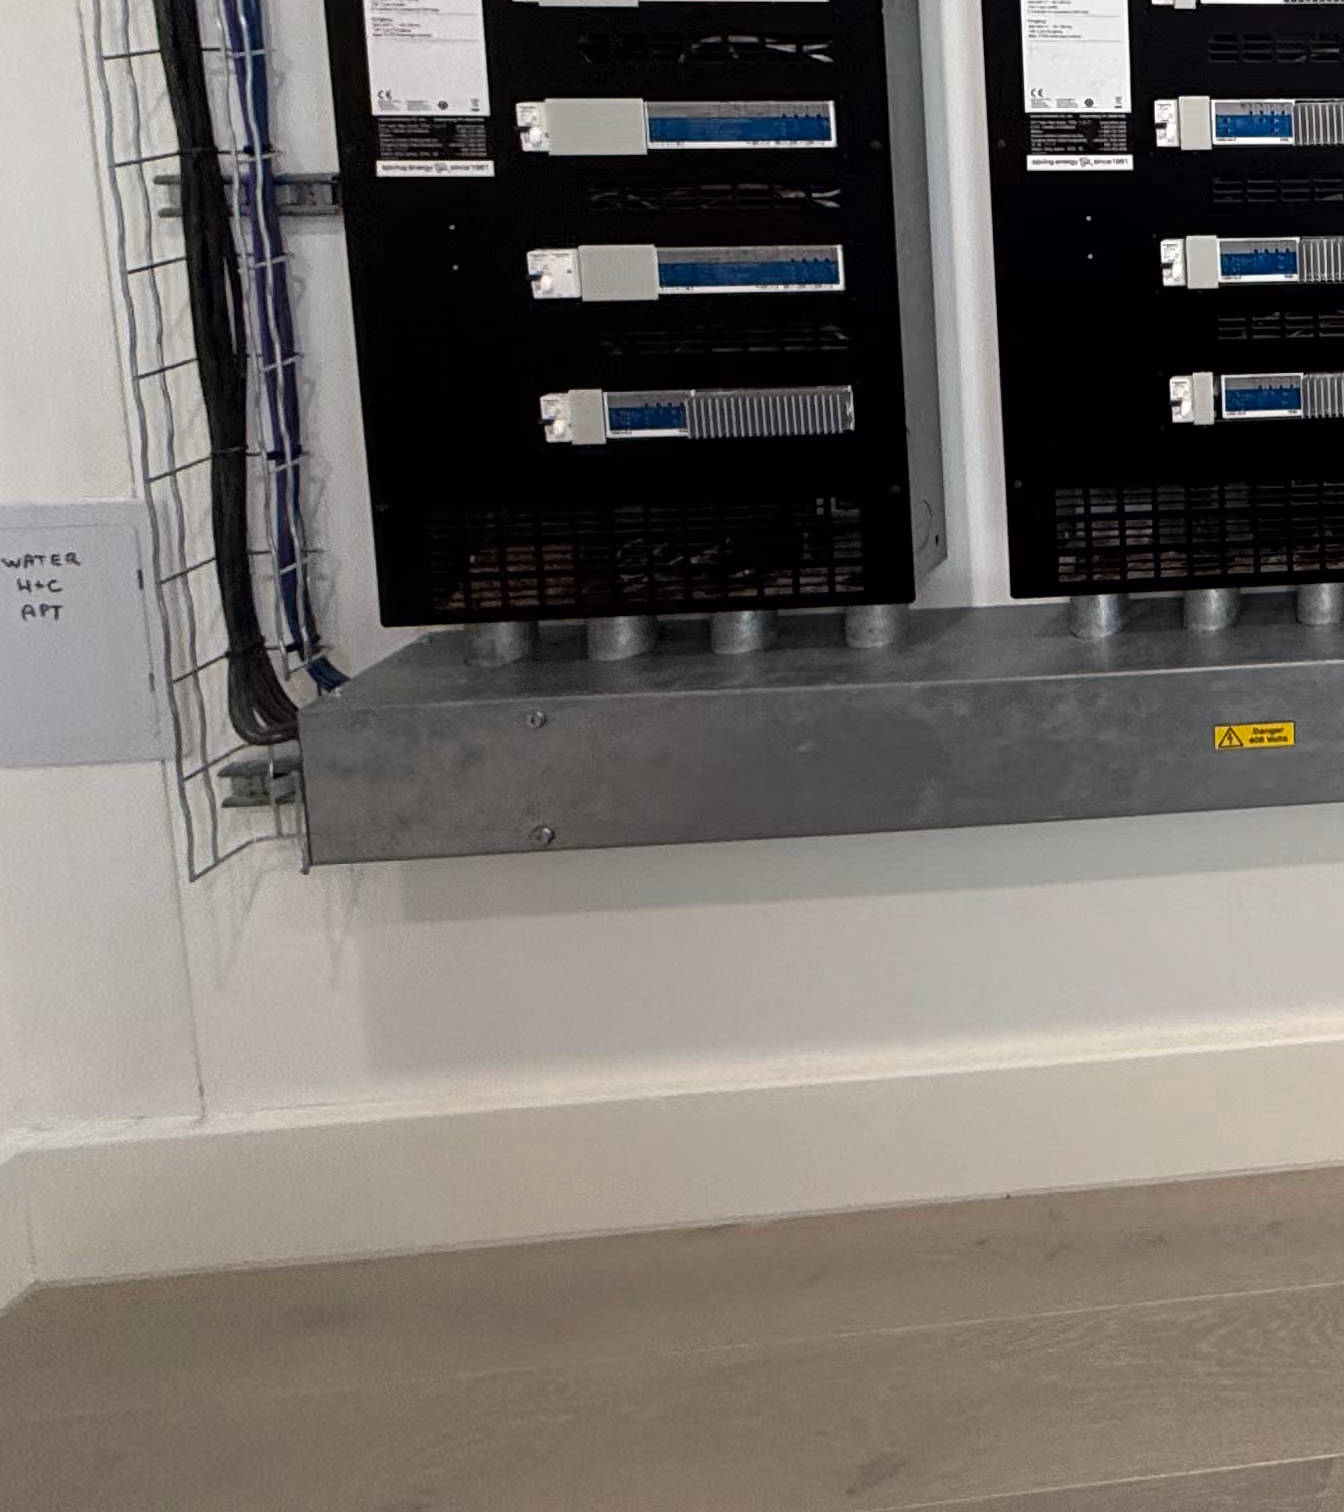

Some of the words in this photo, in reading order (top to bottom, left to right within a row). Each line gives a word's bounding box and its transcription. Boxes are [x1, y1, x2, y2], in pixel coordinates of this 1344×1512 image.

[0, 551, 81, 569] WATER
[20, 603, 63, 621] APT
[1252, 727, 1284, 735] Danger
